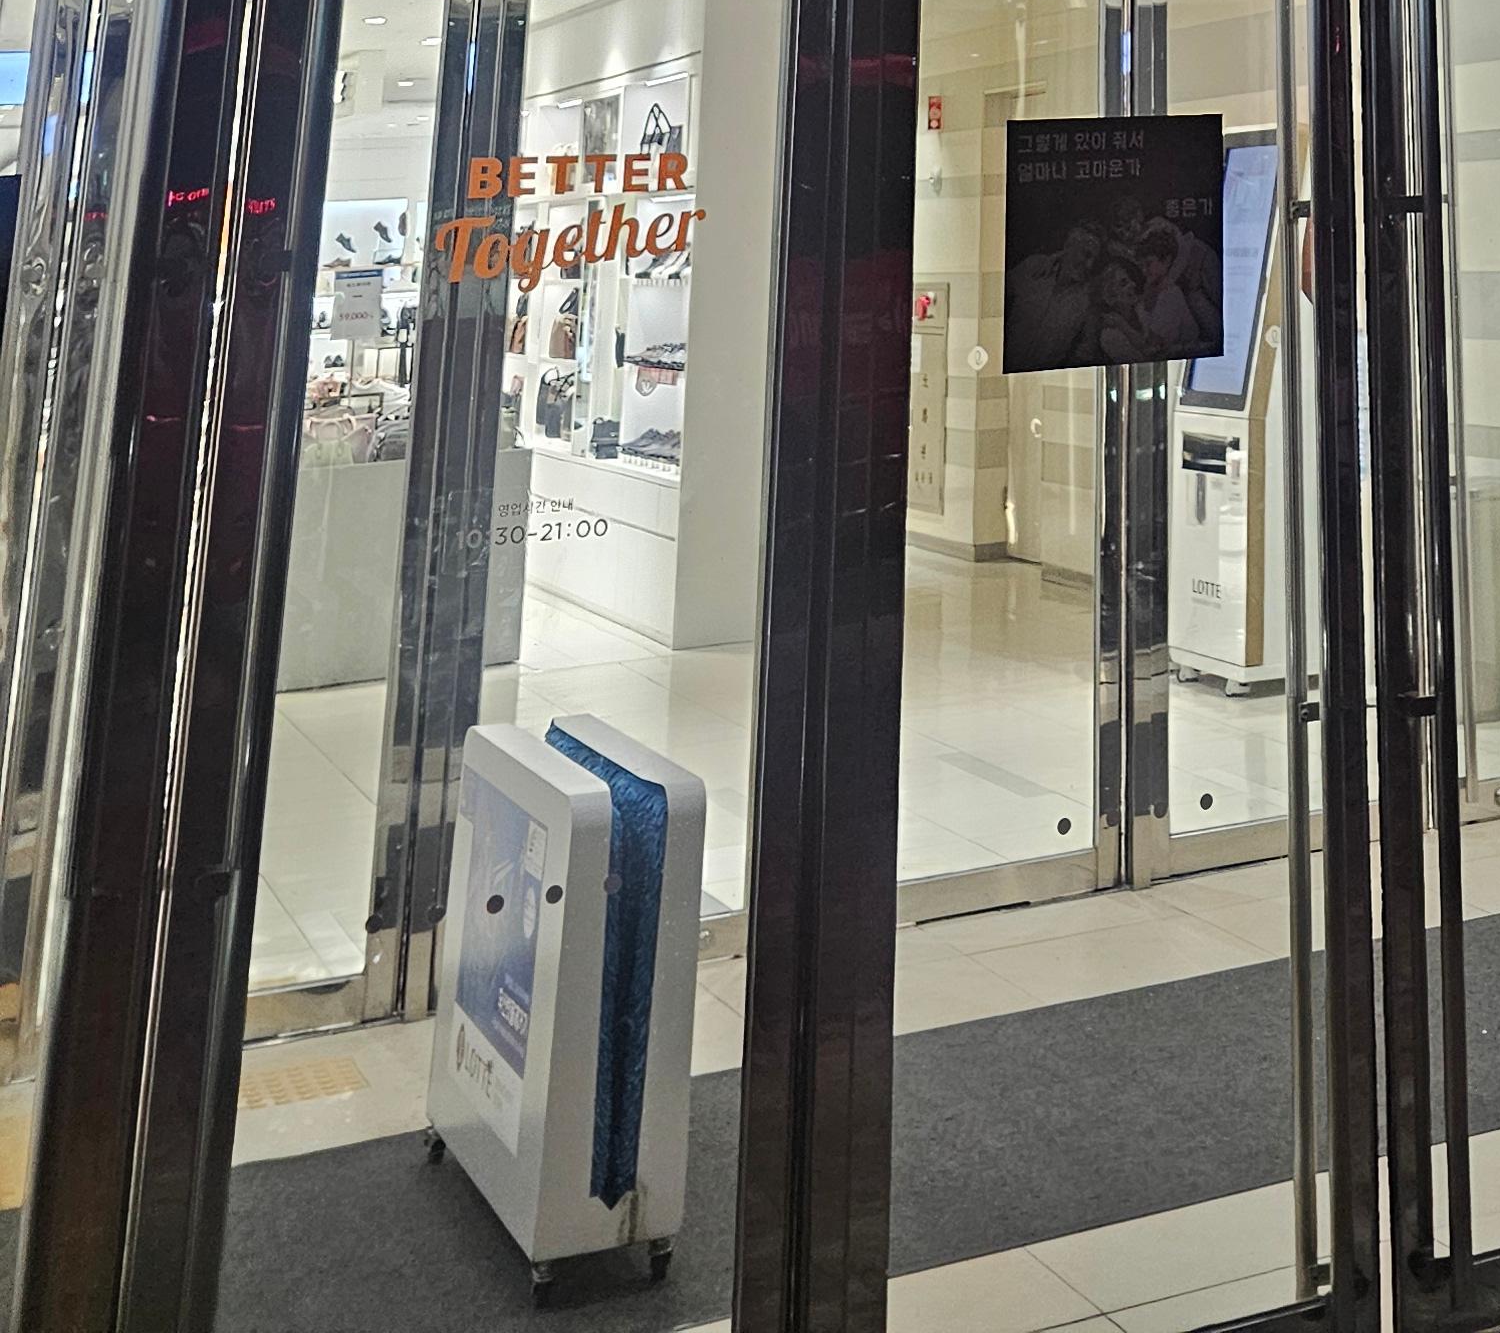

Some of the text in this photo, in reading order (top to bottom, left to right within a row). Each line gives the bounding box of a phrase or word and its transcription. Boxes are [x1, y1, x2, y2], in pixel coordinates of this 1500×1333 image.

[1018, 132, 1068, 154] 그렇게
[466, 152, 689, 200] BETTER
[1018, 157, 1141, 182] 얼마나 고마운가
[434, 202, 707, 294] Together
[498, 497, 574, 517] 영업시간 안내
[1191, 578, 1222, 599] LOTTE
